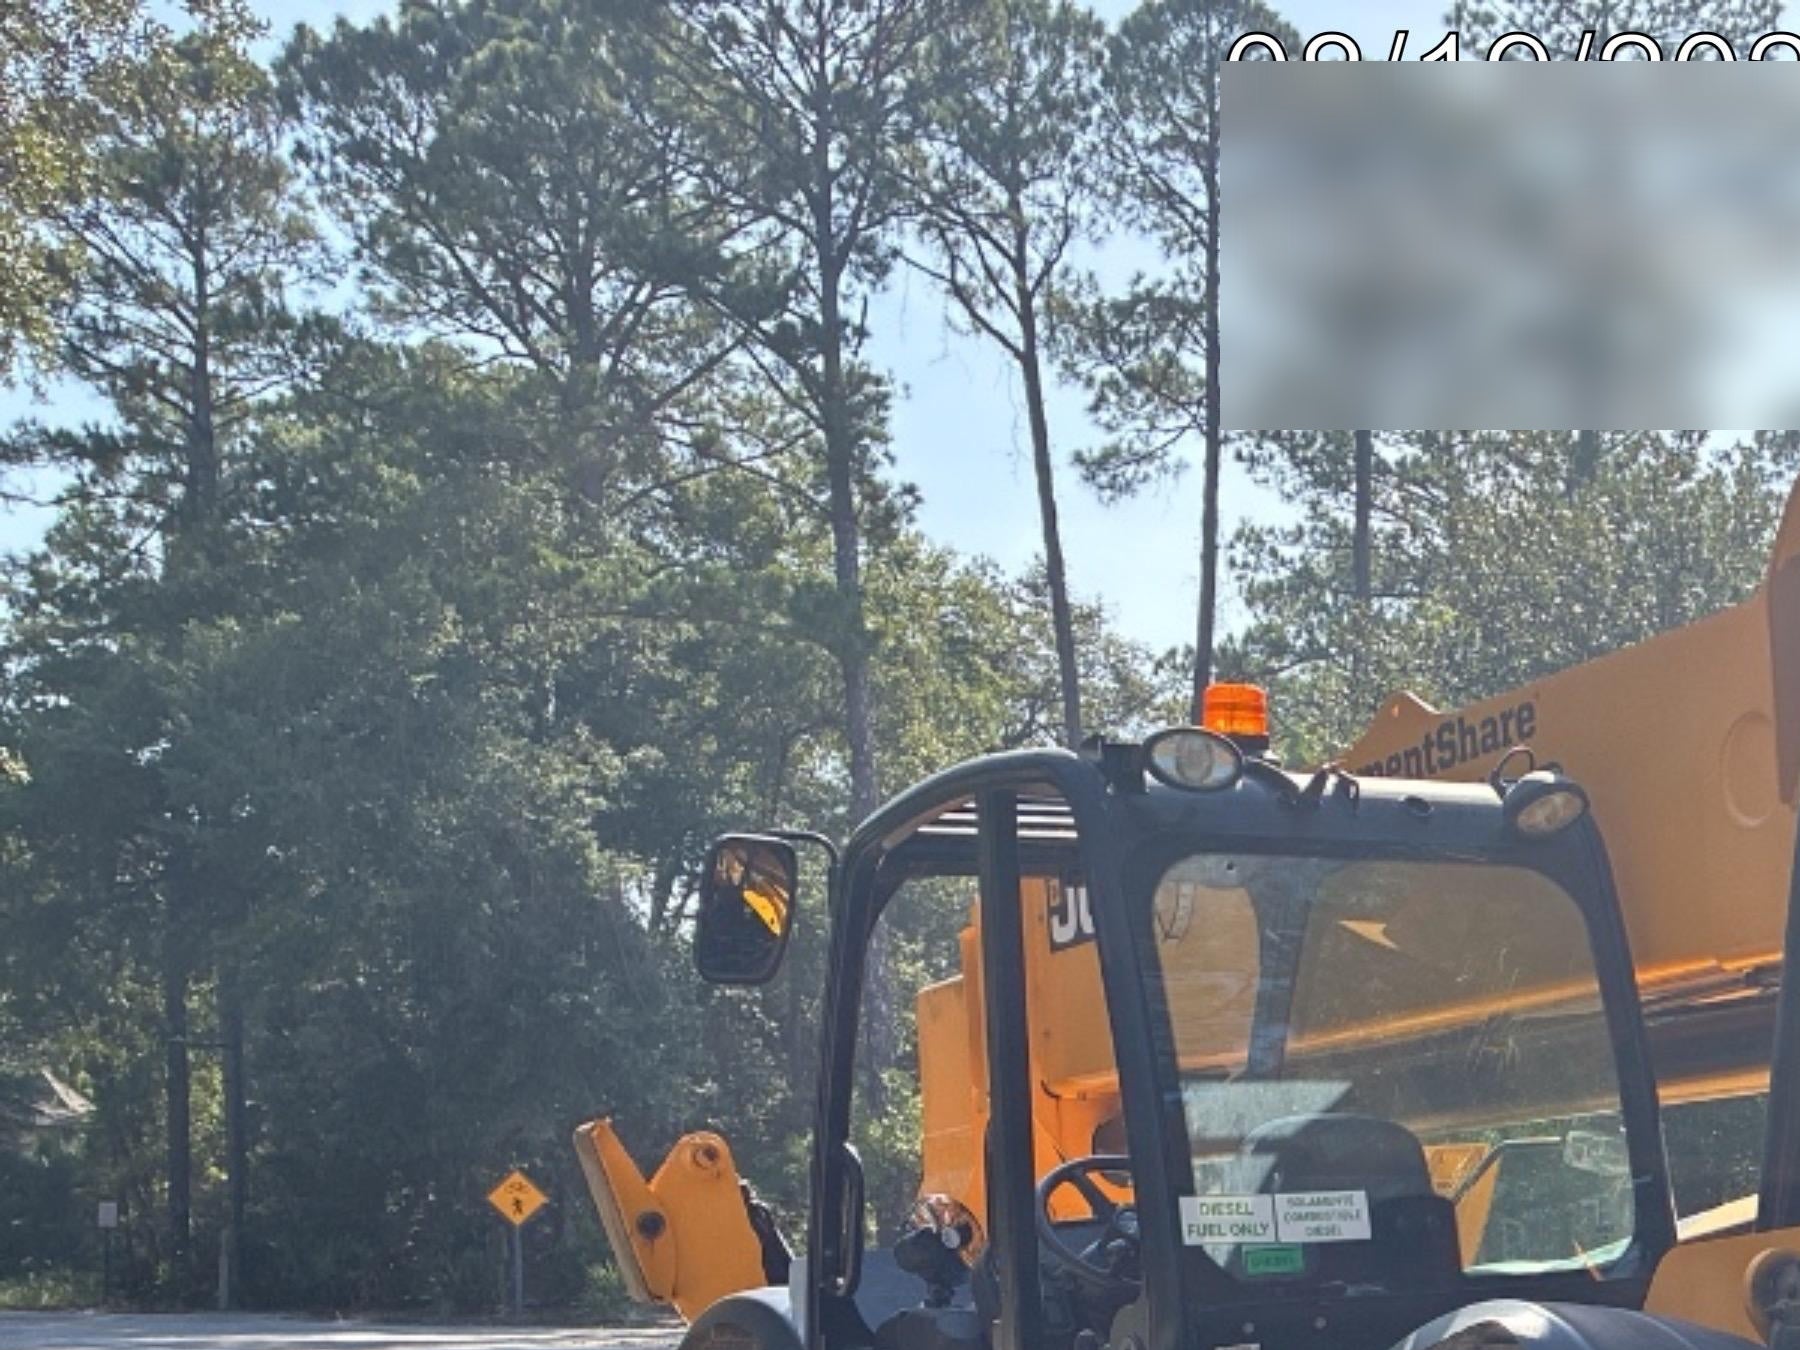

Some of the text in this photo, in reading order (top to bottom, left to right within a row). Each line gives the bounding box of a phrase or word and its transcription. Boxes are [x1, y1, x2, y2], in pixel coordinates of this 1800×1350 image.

[1199, 1202, 1254, 1217] DIESEL
[1187, 1221, 1270, 1237] FUEL ONLY
